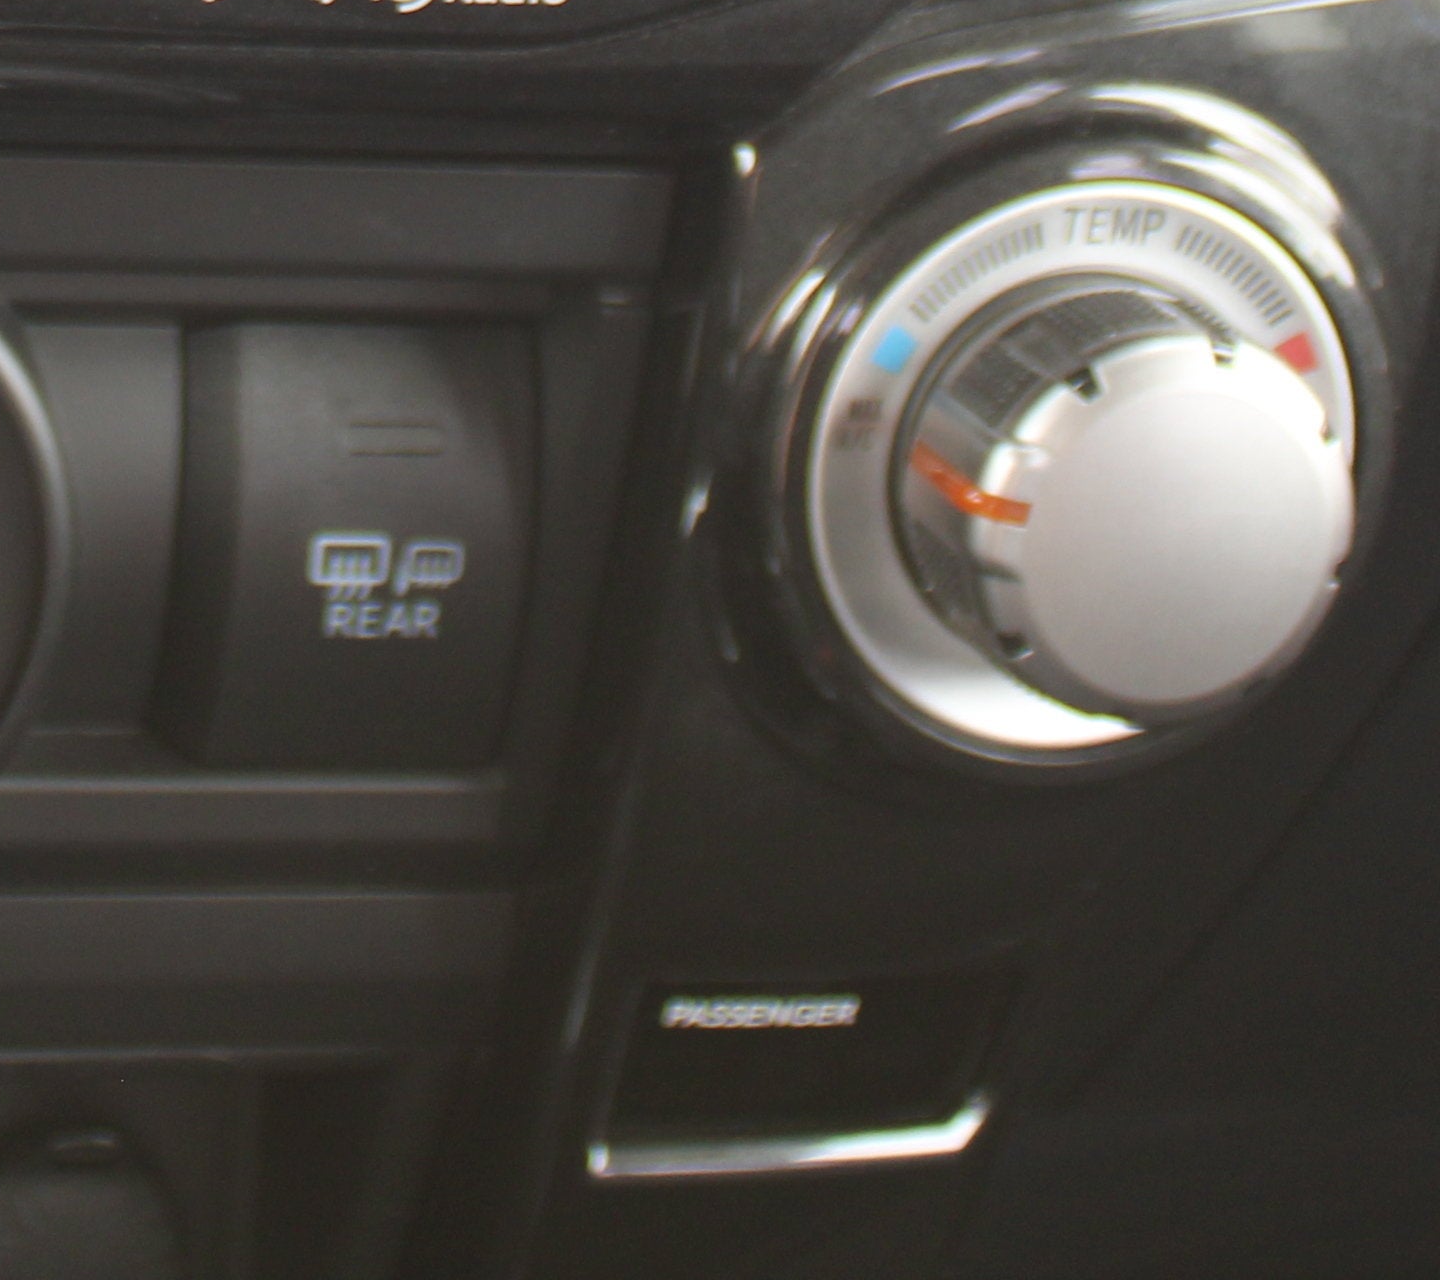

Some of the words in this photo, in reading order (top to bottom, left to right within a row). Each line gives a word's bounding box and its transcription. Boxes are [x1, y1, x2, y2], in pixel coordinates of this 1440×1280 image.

[1062, 203, 1167, 246] TEMP
[323, 601, 442, 640] REAR
[660, 994, 862, 1029] PASSENGER
